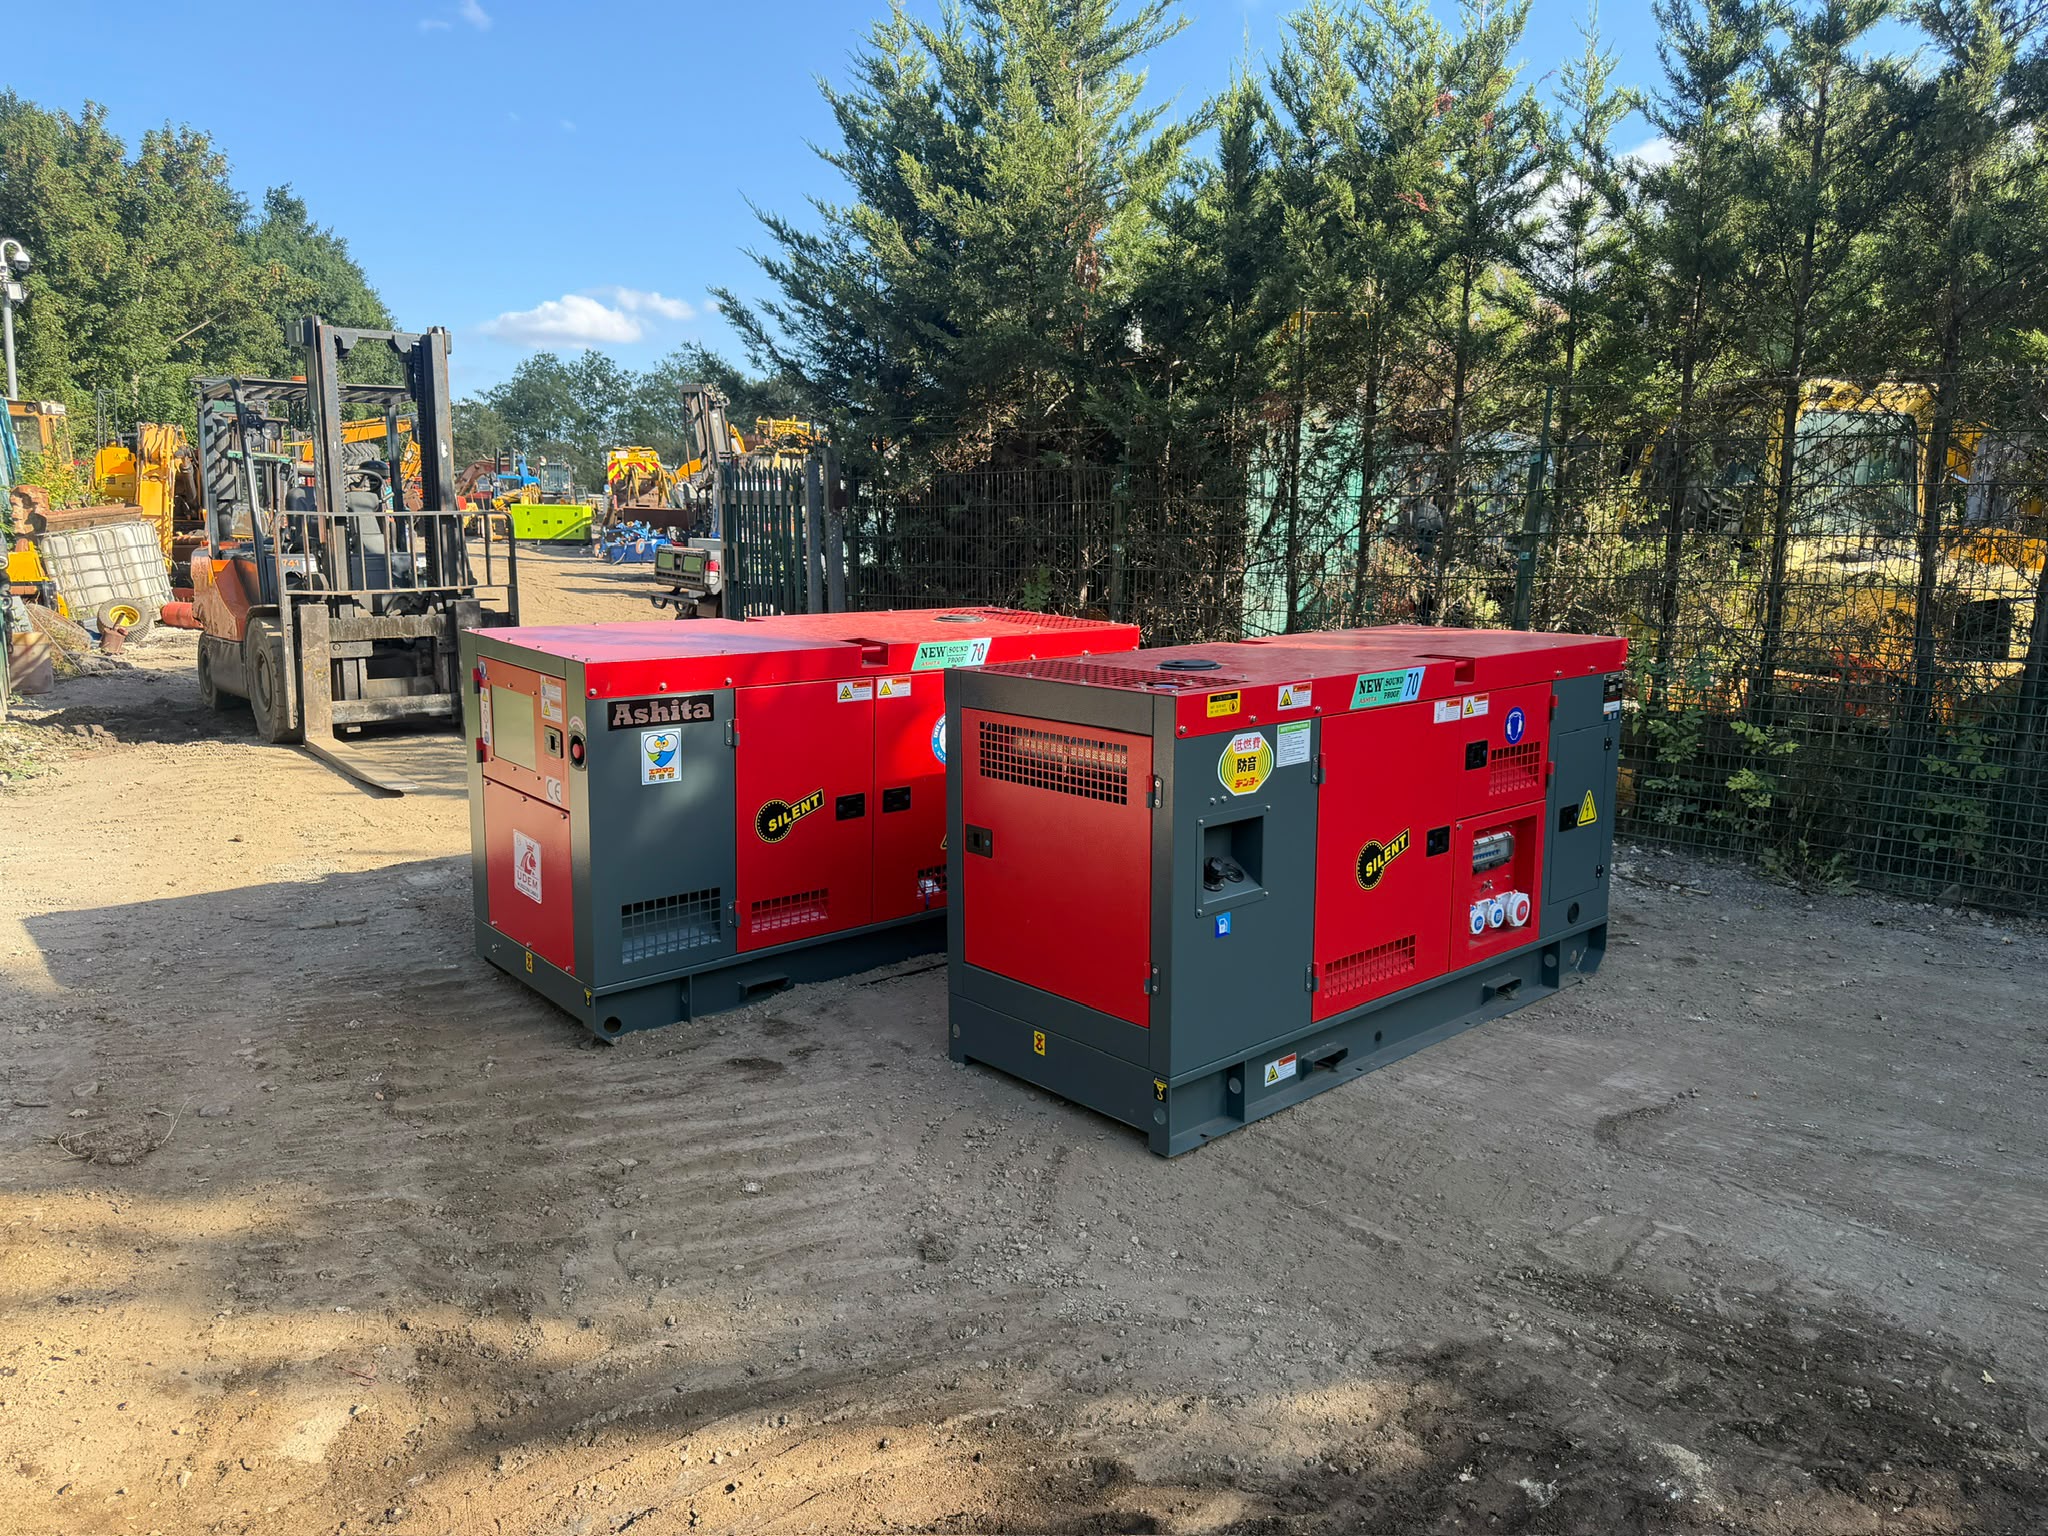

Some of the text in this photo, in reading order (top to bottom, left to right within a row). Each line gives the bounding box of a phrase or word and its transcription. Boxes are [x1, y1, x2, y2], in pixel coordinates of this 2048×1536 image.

[920, 646, 947, 659] NEW
[948, 645, 969, 654] SOUND
[970, 643, 985, 663] 70
[1359, 677, 1384, 695] NEW
[1385, 676, 1404, 686] SOUND
[1405, 672, 1419, 697] 70
[1383, 690, 1400, 700] PROOF
[613, 700, 711, 726] Ashita
[1234, 737, 1261, 752] 低燃費
[1237, 756, 1257, 774] 防音
[1235, 777, 1259, 789] デンヨー
[769, 794, 819, 832] SILENT
[1366, 834, 1406, 877] SILENT
[517, 870, 538, 890] UDEM
